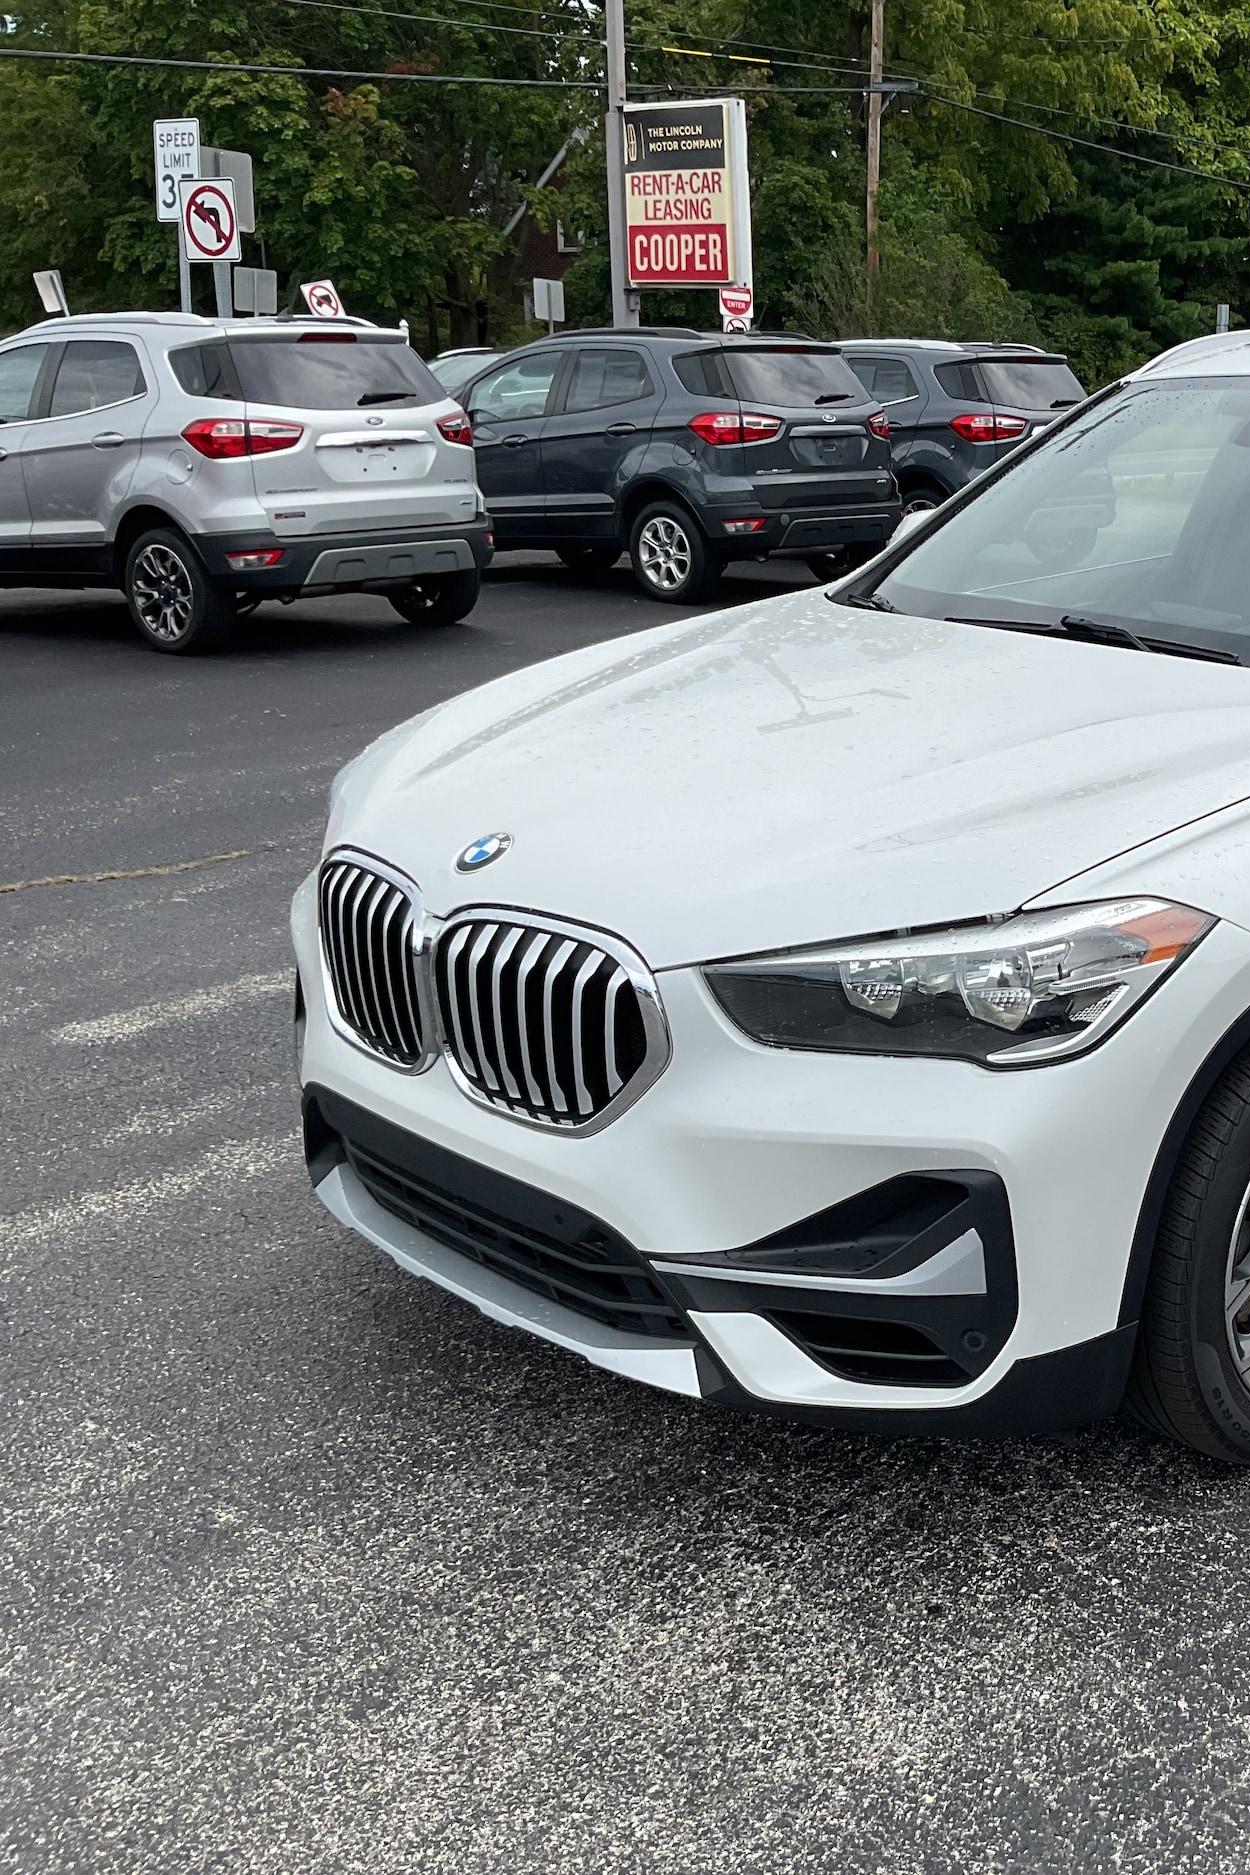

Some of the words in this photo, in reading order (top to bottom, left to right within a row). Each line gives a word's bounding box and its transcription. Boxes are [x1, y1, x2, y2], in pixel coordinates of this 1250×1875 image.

[648, 127, 665, 138] THE
[667, 125, 702, 137] LINCOLN
[159, 132, 195, 148] SPEED
[649, 141, 679, 152] MOTOR
[680, 138, 723, 151] COMPANY
[163, 153, 192, 168] LIMIT
[630, 171, 722, 196] RENT-A-CAR
[644, 198, 712, 221] LEASING
[634, 233, 722, 272] COOPER
[727, 301, 746, 309] ENTER
